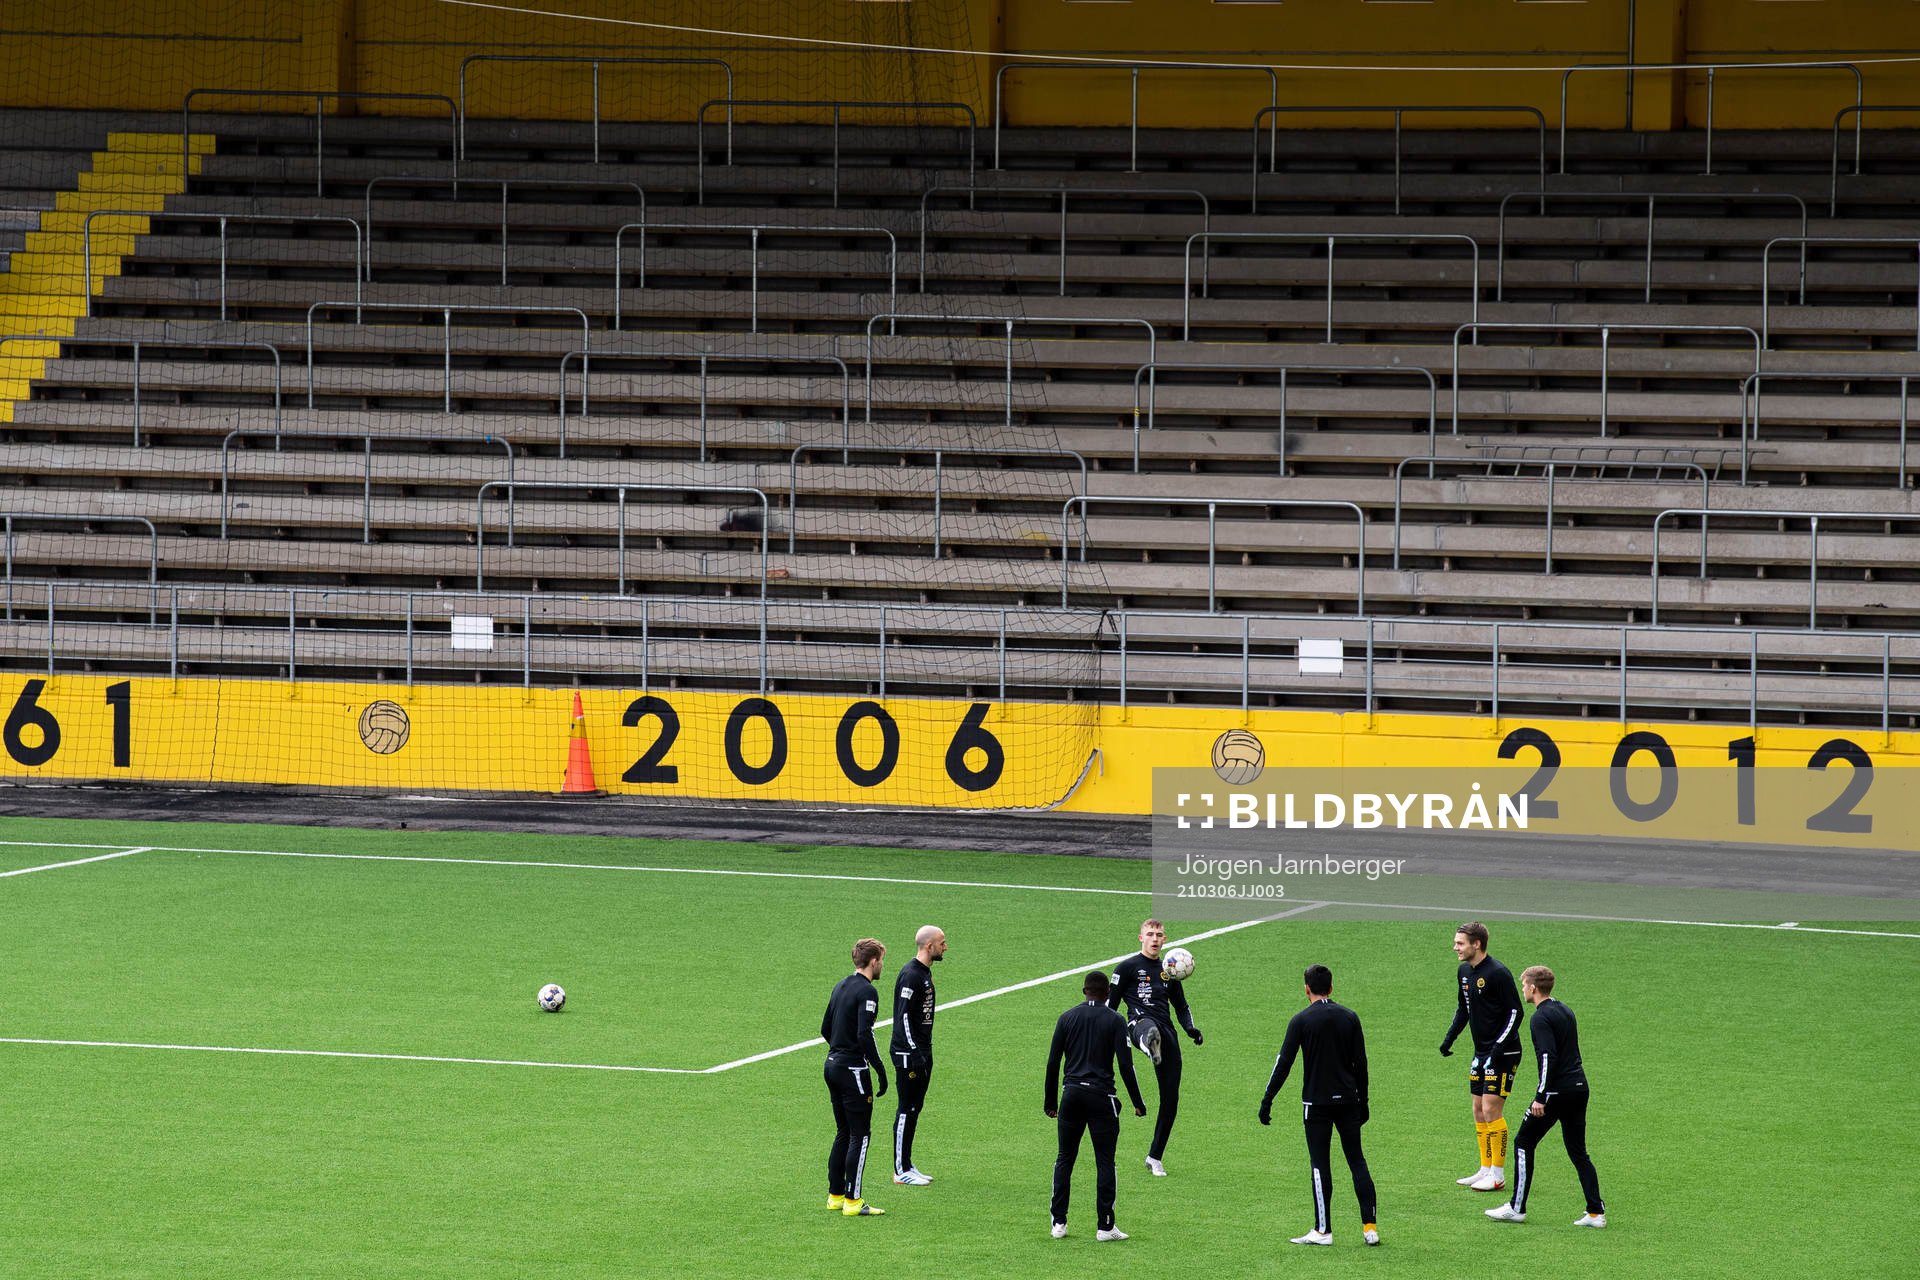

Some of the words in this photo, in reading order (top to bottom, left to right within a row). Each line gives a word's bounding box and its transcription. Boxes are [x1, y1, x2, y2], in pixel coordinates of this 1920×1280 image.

[3, 679, 130, 767] 61
[622, 695, 1005, 792] 2006
[1497, 727, 1874, 833] 2012
